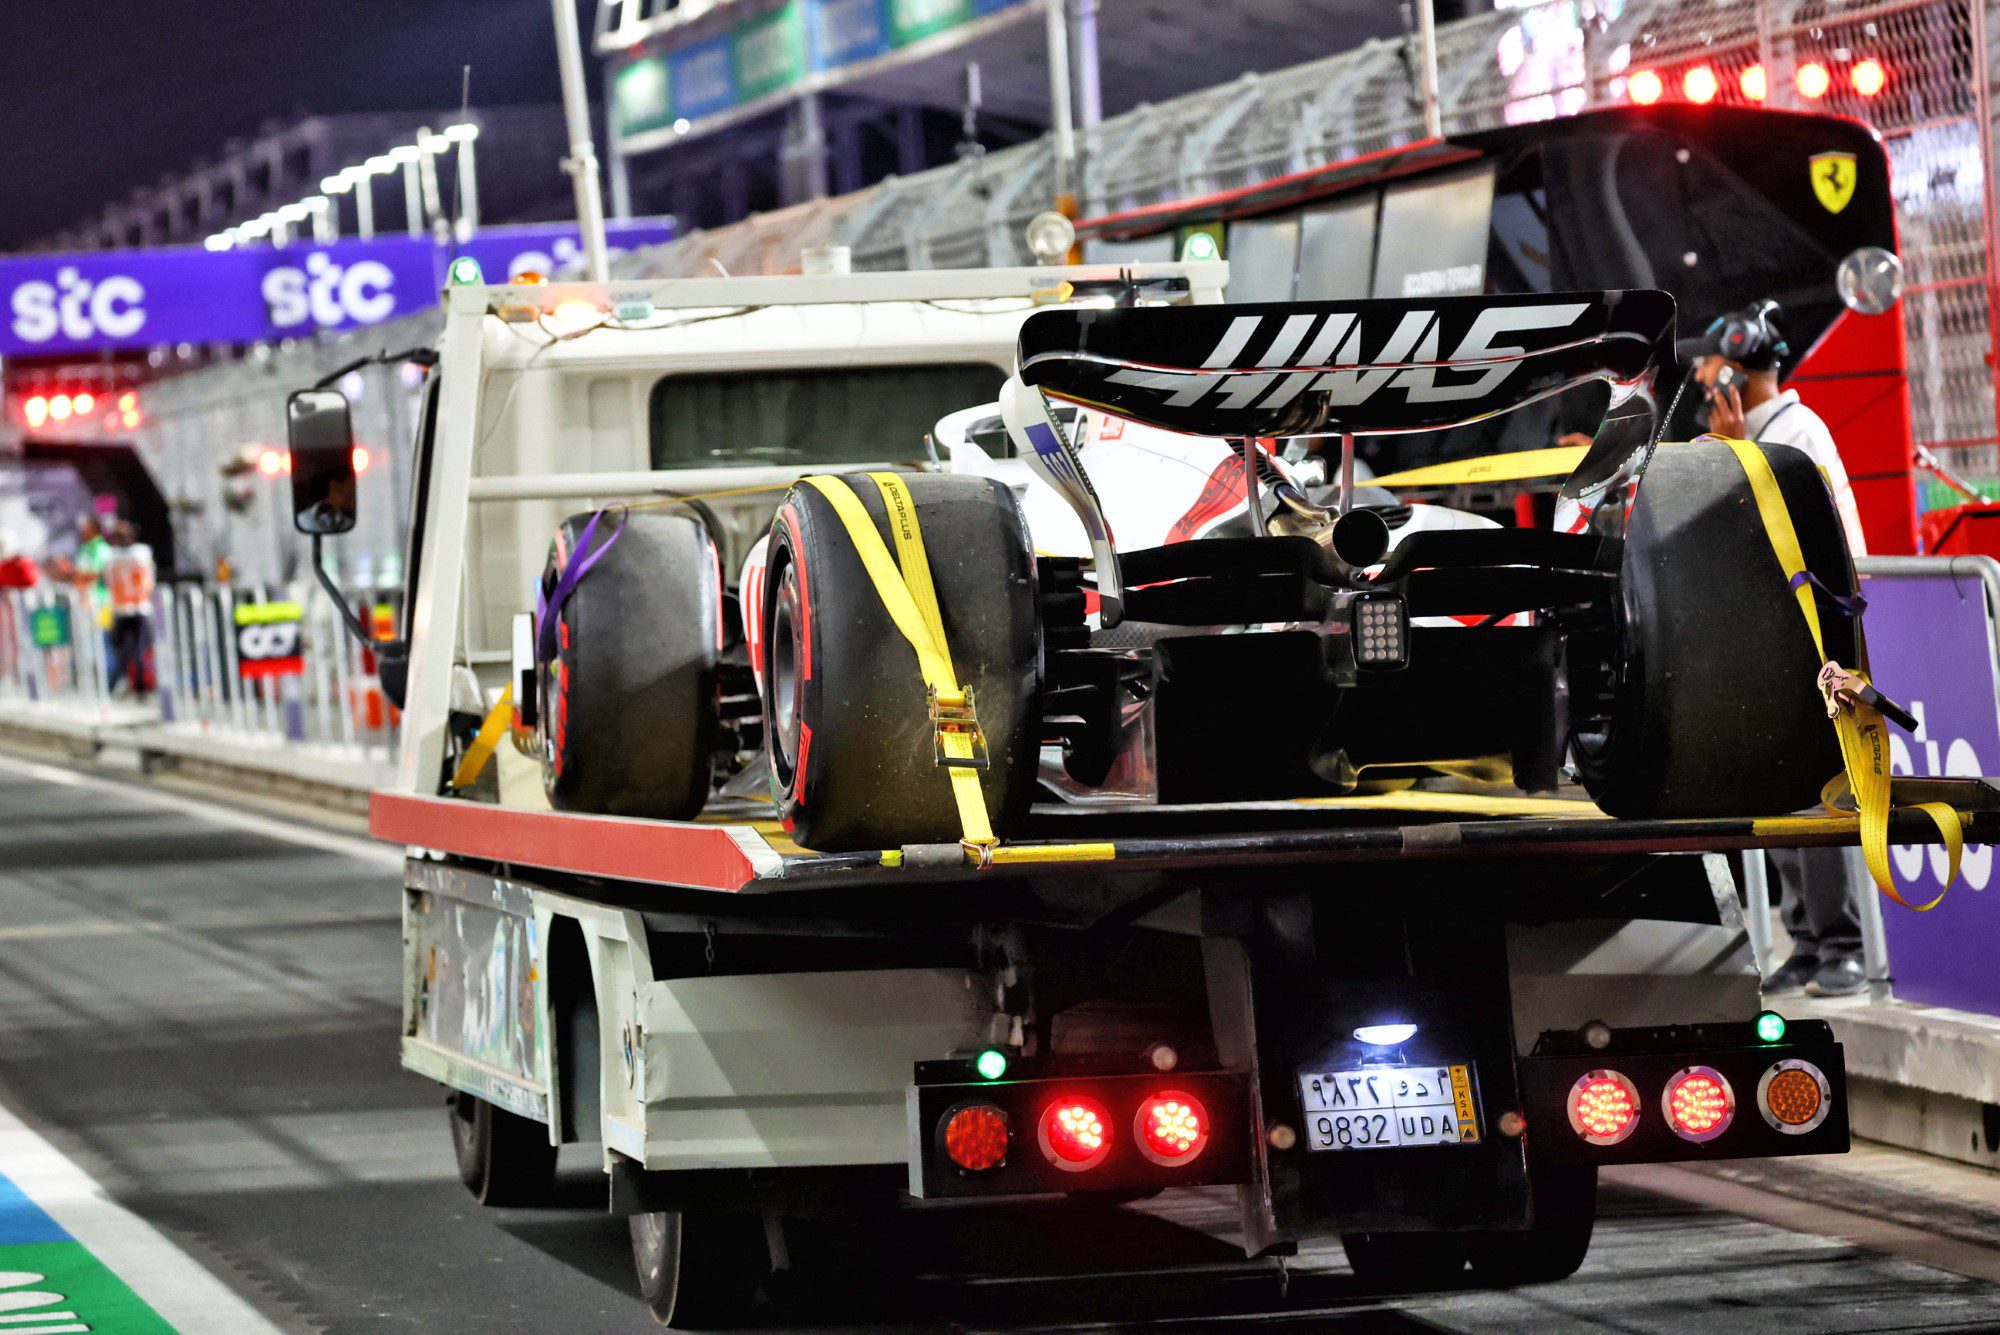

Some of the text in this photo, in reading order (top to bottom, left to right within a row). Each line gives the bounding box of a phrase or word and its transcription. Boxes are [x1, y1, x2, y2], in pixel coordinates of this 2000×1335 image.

[12, 266, 146, 342] stc
[262, 252, 395, 327] stc
[1104, 302, 1591, 409] HAAS
[889, 486, 912, 540] DELTAPLUS
[1317, 1114, 1454, 1146] 9832 UDA
[1458, 1090, 1469, 1118] KSA
